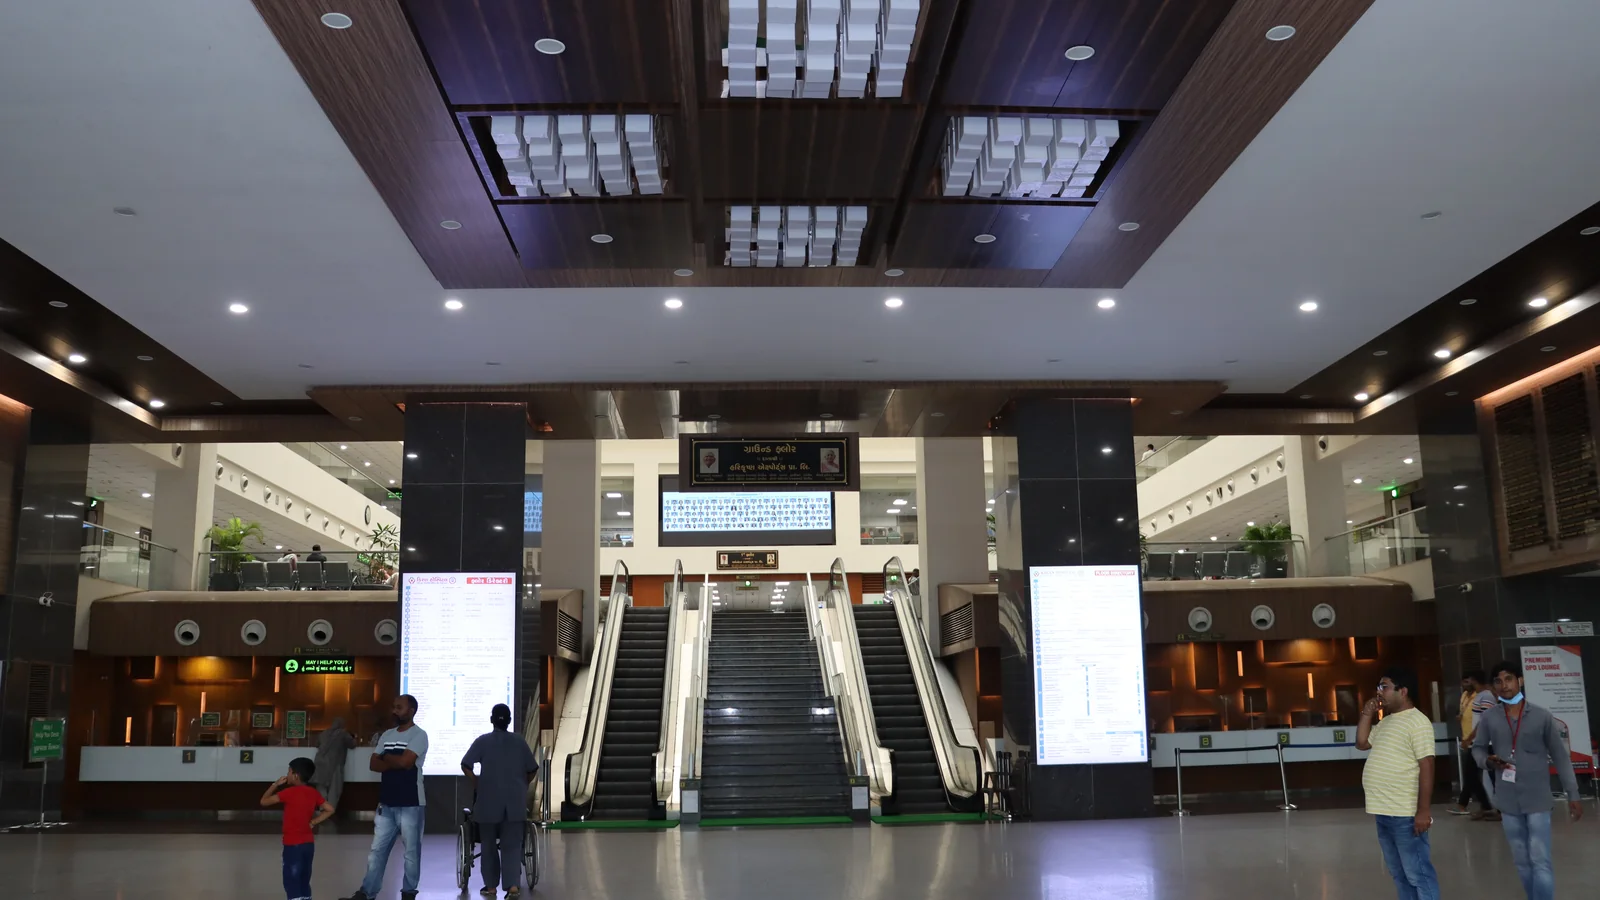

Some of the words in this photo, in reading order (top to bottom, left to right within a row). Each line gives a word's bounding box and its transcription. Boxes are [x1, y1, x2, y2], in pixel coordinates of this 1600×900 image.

[743, 444, 772, 453] ગ્રાઉન્ડ
[1280, 734, 1287, 742] 9
[1335, 731, 1344, 740] 10
[1202, 737, 1209, 746] 8
[186, 752, 191, 760] 1
[243, 752, 249, 761] 2
